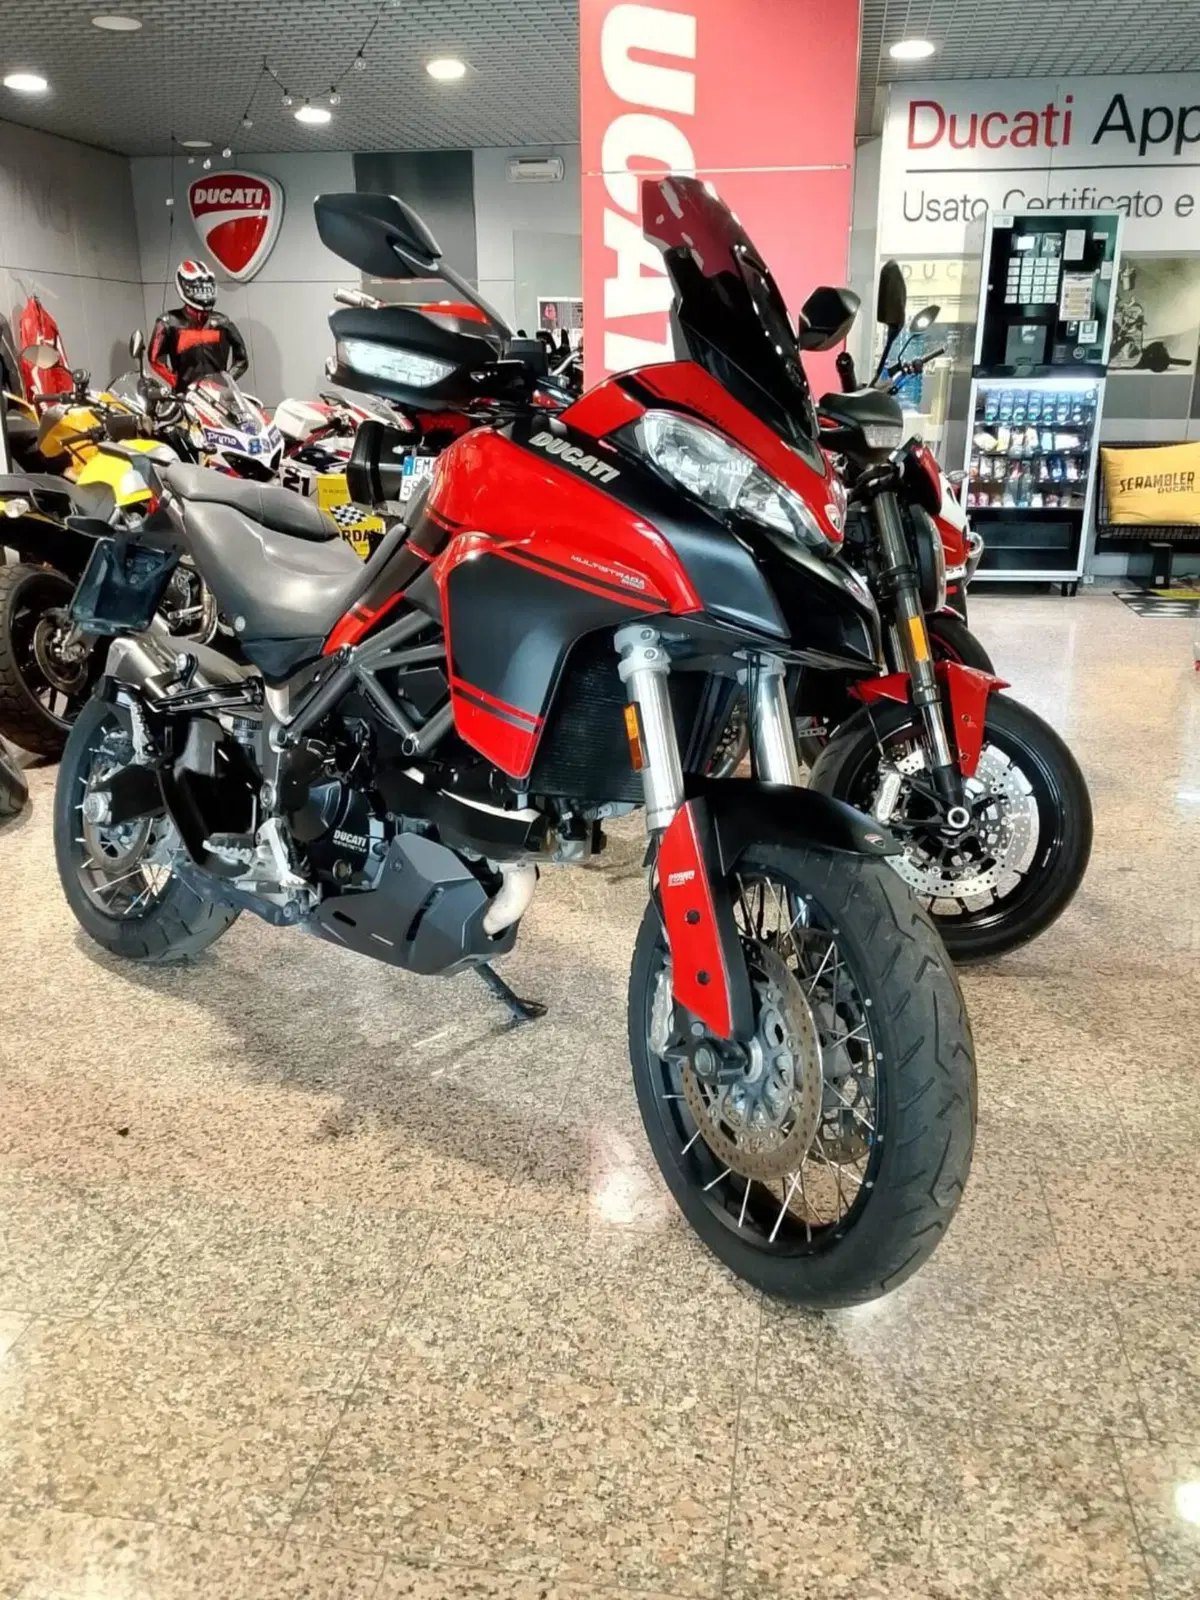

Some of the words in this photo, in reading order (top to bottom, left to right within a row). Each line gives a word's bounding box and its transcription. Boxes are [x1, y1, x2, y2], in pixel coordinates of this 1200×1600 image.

[908, 94, 1074, 150] Ducati
[1091, 93, 1200, 156] App
[194, 188, 263, 205] DUCATI
[903, 190, 989, 222] Usato
[1174, 194, 1194, 217] e
[528, 431, 620, 483] DUCATI
[282, 468, 310, 497] 21
[1120, 471, 1195, 493] SCRAMBLER
[1157, 485, 1195, 495] DUCATI
[333, 829, 367, 847] DUCATI
